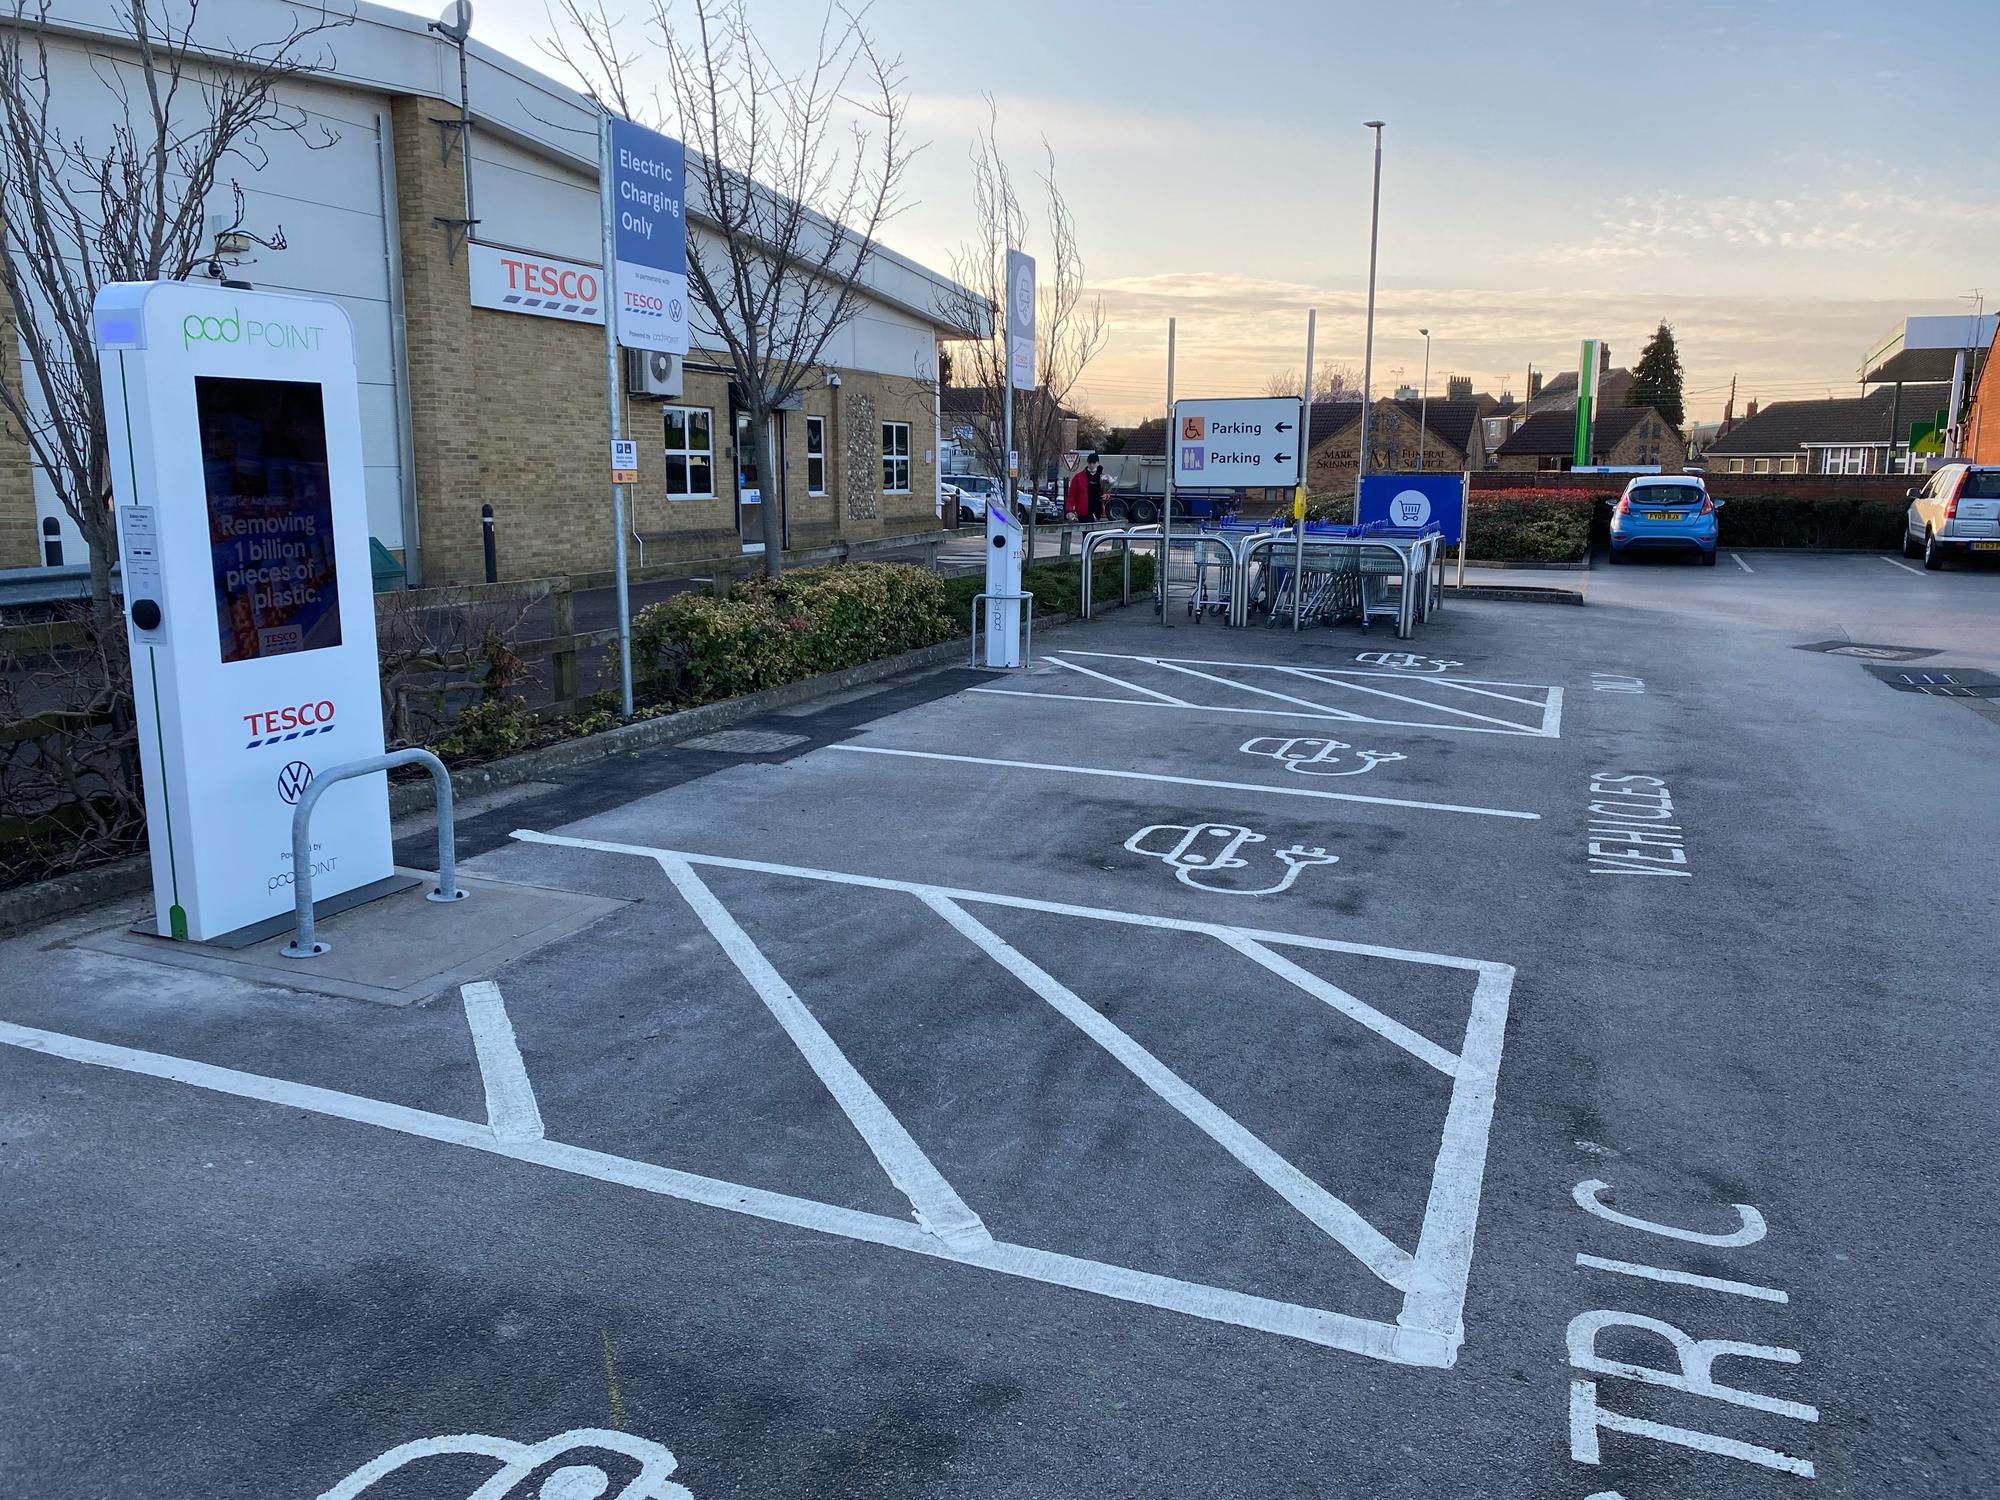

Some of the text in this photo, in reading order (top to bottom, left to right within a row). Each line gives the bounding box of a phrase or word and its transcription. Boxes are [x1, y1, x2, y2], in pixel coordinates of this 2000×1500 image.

[620, 148, 672, 181] Electric
[621, 180, 679, 218] Charging
[622, 211, 652, 240] Only
[500, 259, 597, 302] TESCO
[624, 291, 663, 311] TESCO
[247, 320, 324, 351] POINT
[1211, 421, 1262, 436] Parking
[1210, 451, 1261, 466] Parking
[1317, 459, 1359, 469] SKINNER
[1324, 449, 1352, 459] MARK
[1403, 458, 1444, 468] SEVICE
[221, 511, 317, 537] Removing
[234, 538, 306, 562] 1 billion
[226, 559, 314, 592] pieces of
[254, 584, 321, 615] plastic.
[994, 584, 1002, 611] PONT
[263, 631, 297, 644] TESCO
[243, 700, 335, 736] TESCO
[1587, 772, 1693, 877] VEHICLES
[310, 857, 337, 877] OINT
[1566, 1178, 1819, 1500] TRIC
